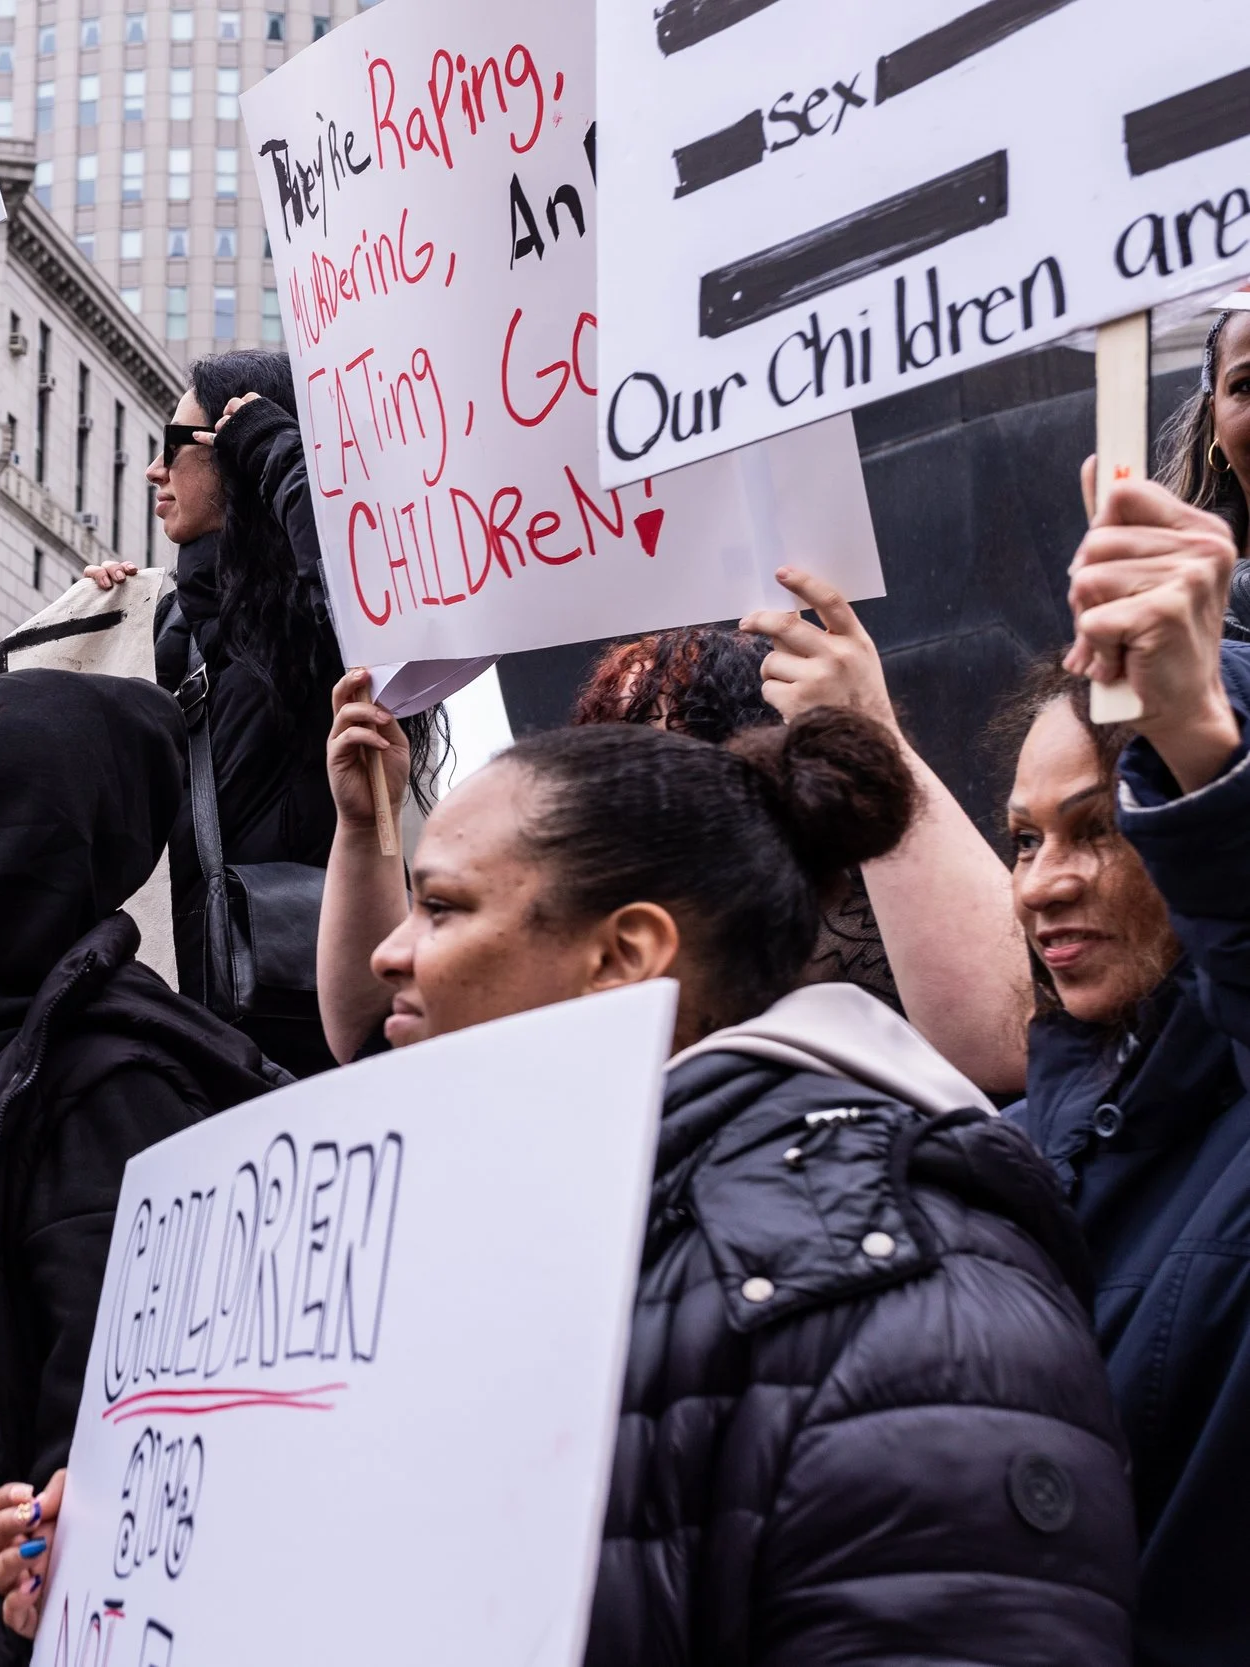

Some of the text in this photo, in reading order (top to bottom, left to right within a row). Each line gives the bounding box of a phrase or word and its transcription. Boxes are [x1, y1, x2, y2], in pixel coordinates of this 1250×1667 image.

[607, 370, 747, 461] Our
[1114, 186, 1250, 280] are
[103, 1131, 405, 1405] CHILDREN
